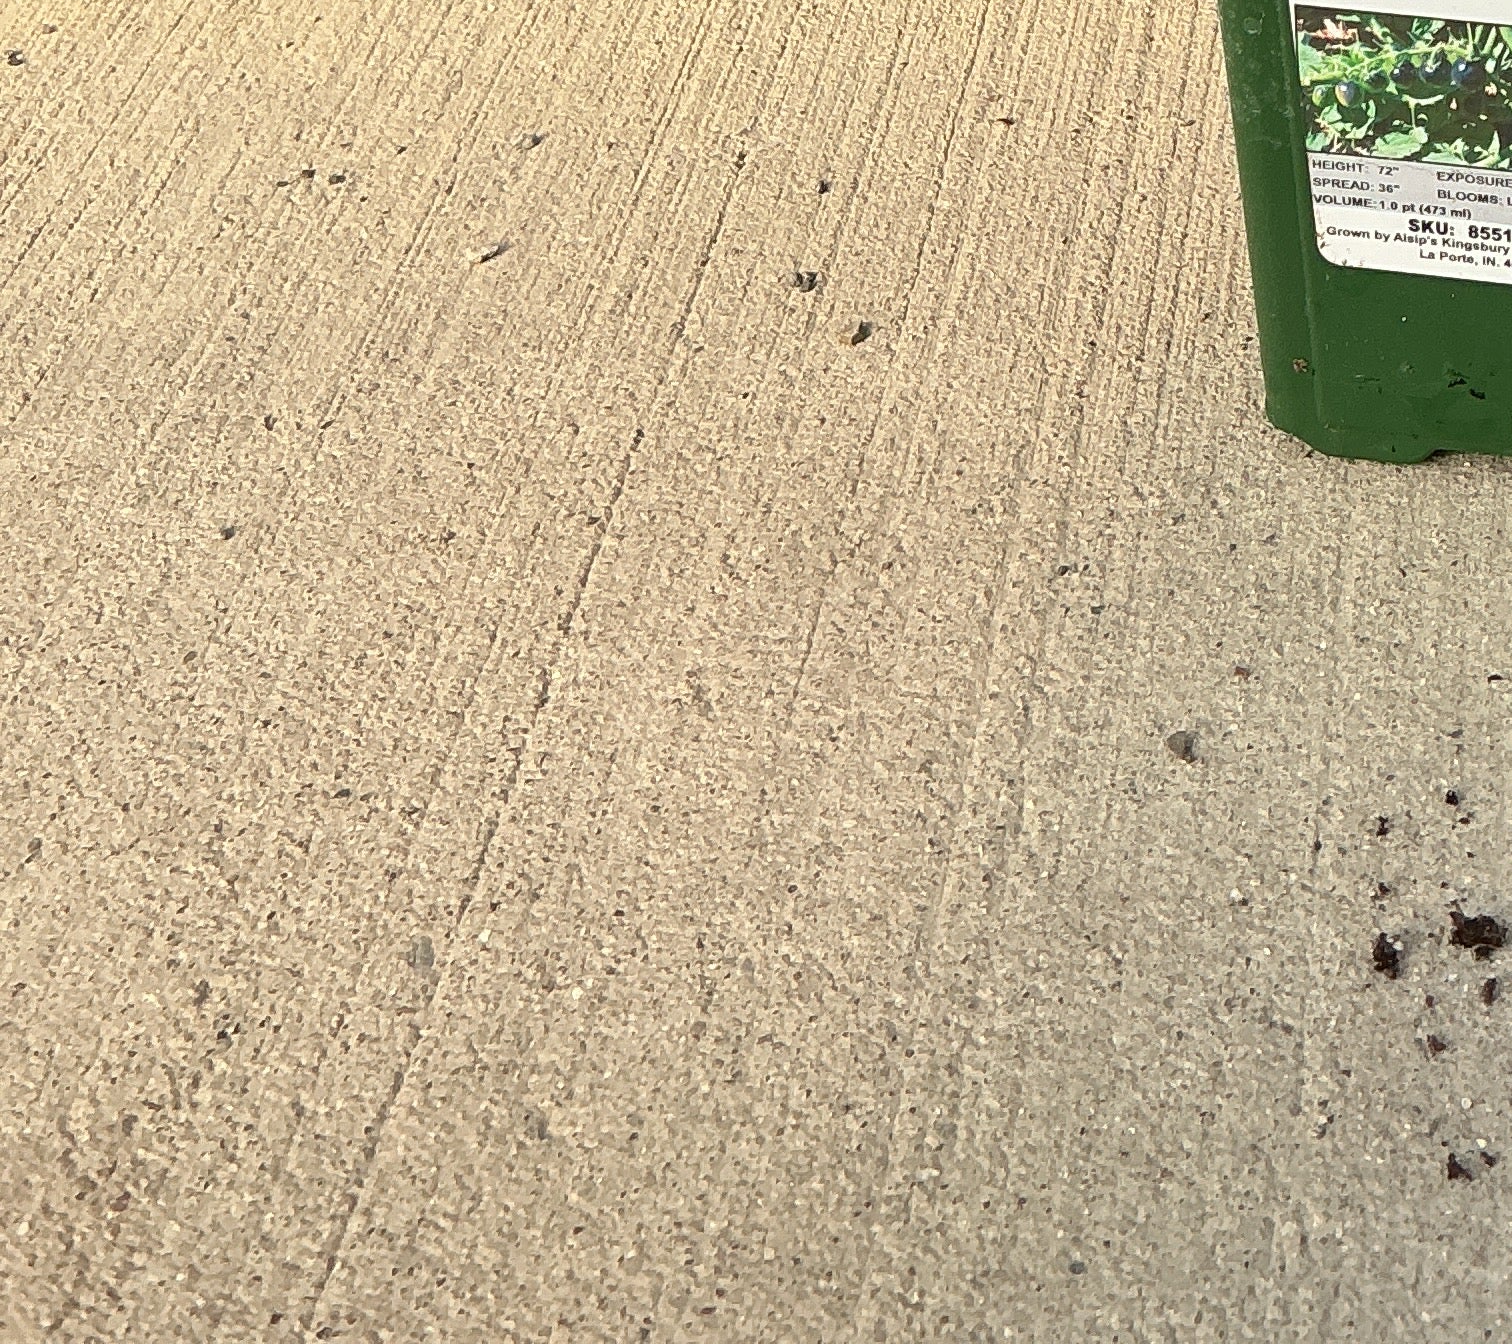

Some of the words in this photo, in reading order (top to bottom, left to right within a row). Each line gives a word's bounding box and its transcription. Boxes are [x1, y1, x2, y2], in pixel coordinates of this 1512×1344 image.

[1311, 159, 1369, 173] HEIGHT:
[1312, 177, 1374, 192] SPREAD:
[1437, 189, 1503, 206] BLOOMS:
[1379, 200, 1398, 211] 1.0
[1402, 203, 1416, 214] pt
[1419, 204, 1447, 216] (473
[1408, 218, 1455, 237] SKU:
[1326, 226, 1370, 239] Grown
[1374, 230, 1391, 243] by
[1442, 238, 1510, 256] Kingsbury
[1419, 249, 1435, 260] La
